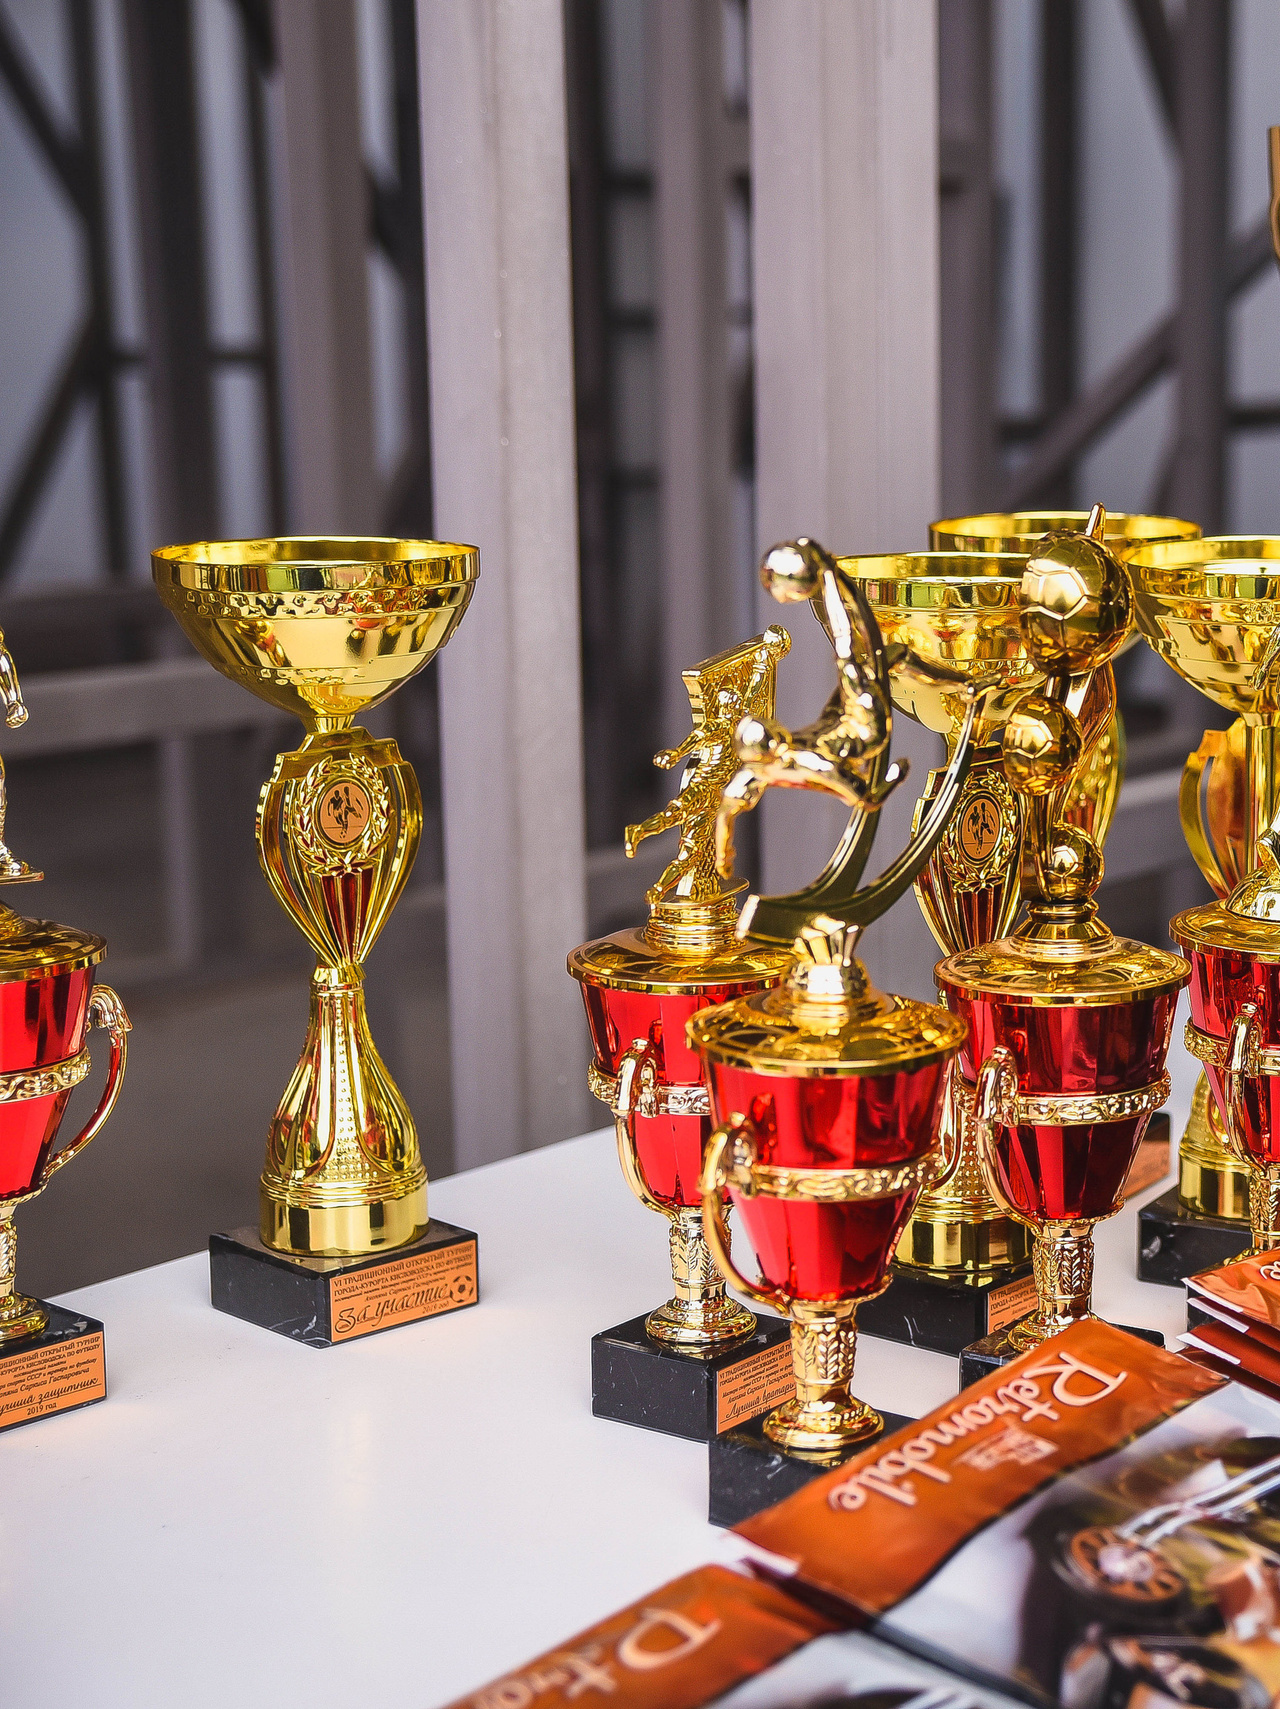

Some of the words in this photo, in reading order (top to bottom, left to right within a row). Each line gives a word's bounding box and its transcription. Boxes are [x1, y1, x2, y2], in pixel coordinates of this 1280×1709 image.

[334, 1305, 371, 1333] За
[371, 1284, 449, 1326] участие
[38, 1378, 98, 1403] защитник
[27, 1404, 43, 1415] 2019
[828, 1351, 1128, 1512] Retromobile
